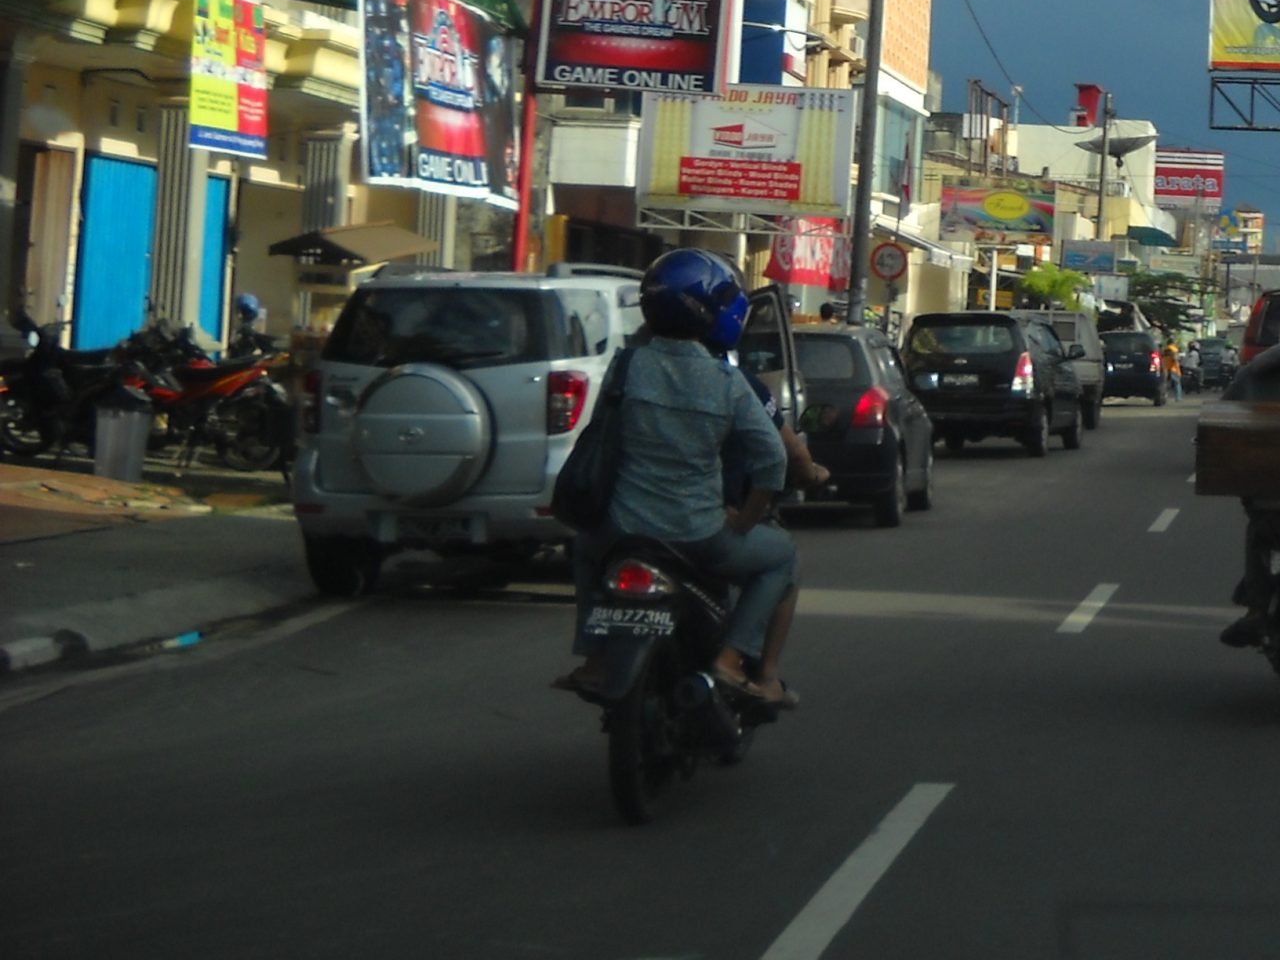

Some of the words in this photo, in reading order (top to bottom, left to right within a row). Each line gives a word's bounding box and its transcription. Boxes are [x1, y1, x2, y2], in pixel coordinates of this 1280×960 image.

[583, 21, 602, 33] THE
[602, 23, 641, 35] GAMERS
[641, 26, 674, 38] DREAM
[553, 64, 619, 86] GAME
[622, 69, 705, 91] ONLINE
[752, 90, 799, 106] JAYA
[417, 151, 453, 180] GAME
[762, 163, 789, 172] Blinds
[707, 176, 733, 186] Blinds
[717, 168, 743, 178] Blinds
[773, 172, 799, 182] Blinds
